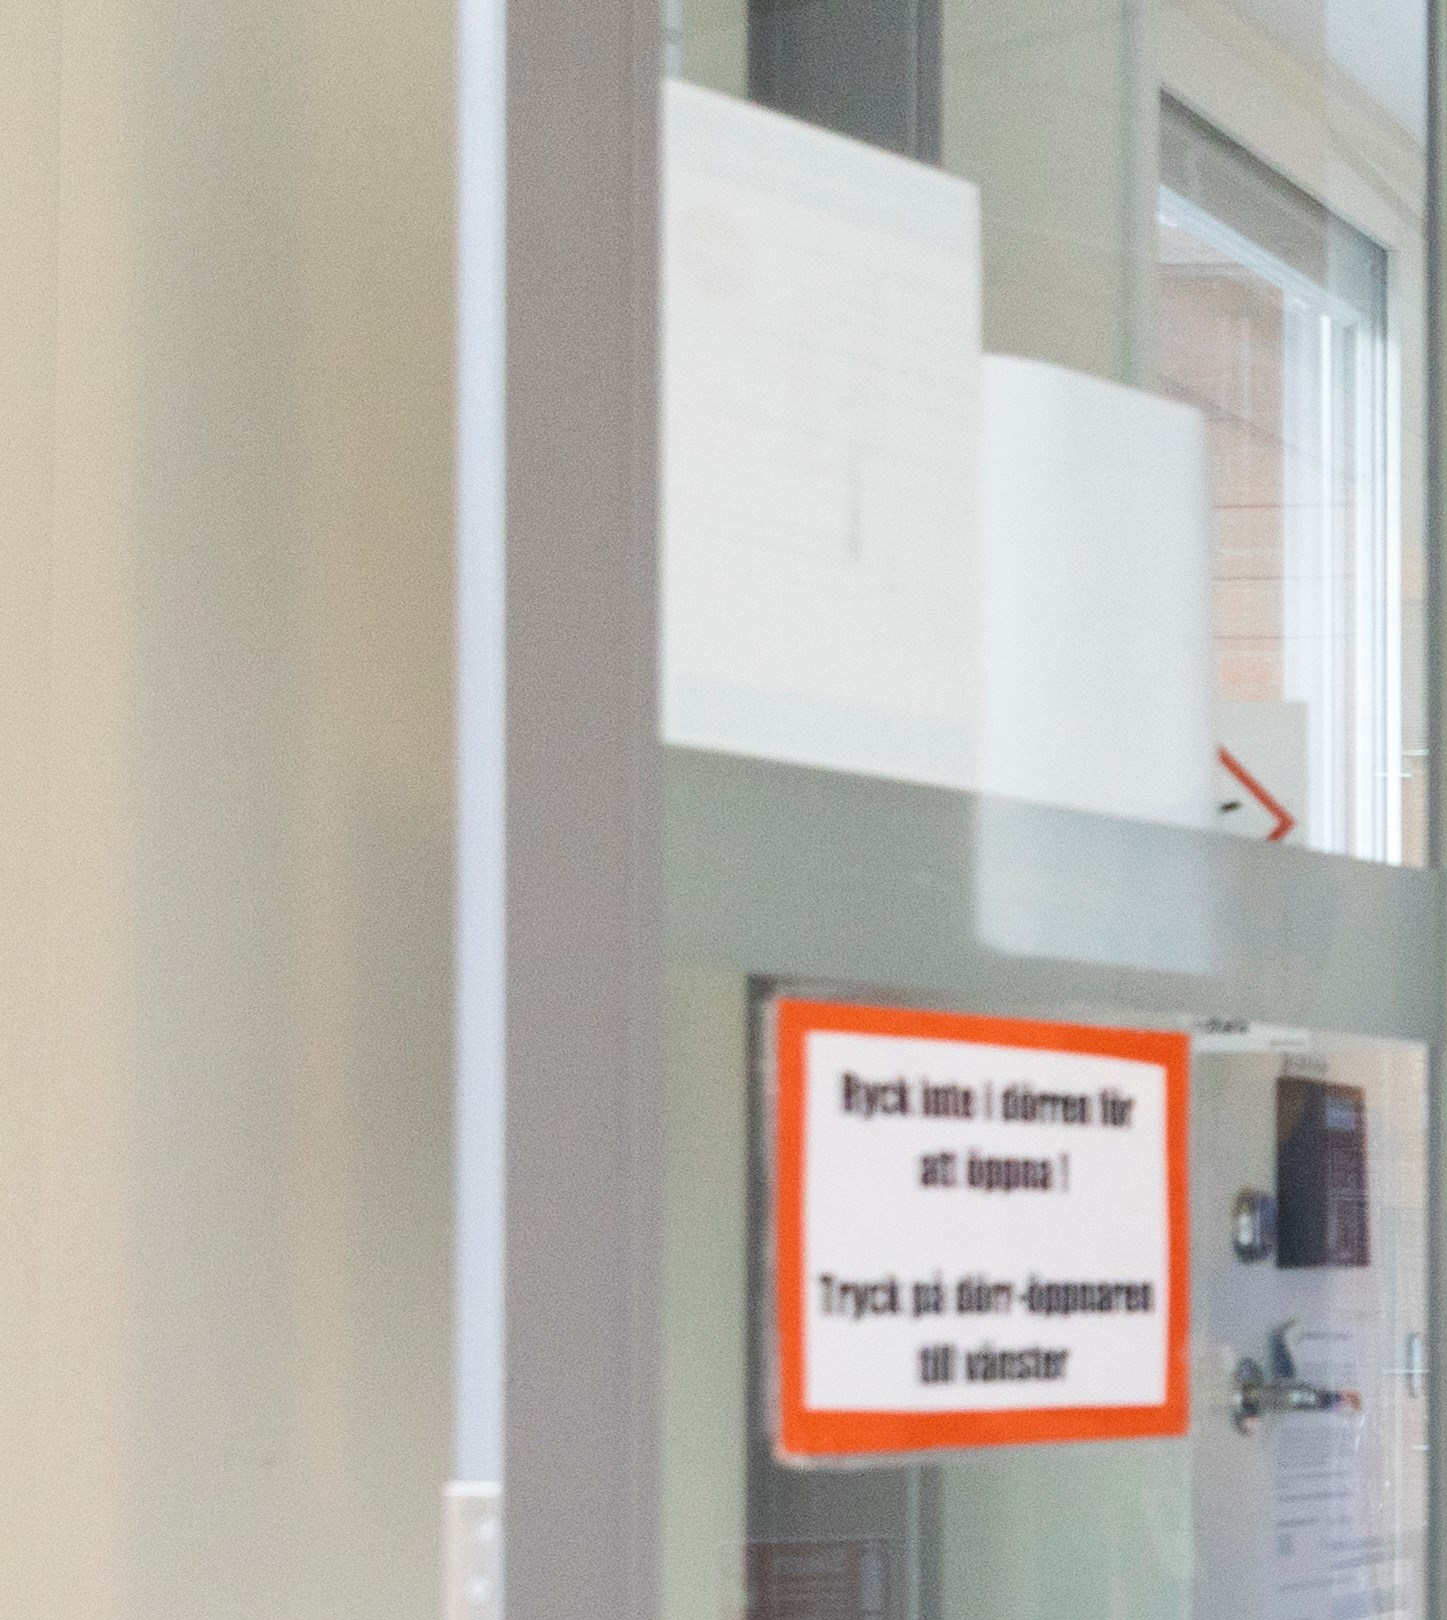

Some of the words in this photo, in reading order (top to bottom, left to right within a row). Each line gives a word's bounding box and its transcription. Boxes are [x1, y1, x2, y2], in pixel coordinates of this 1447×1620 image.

[841, 1071, 910, 1119] Ryck
[919, 1075, 973, 1119] inte
[983, 1078, 993, 1121] i
[1001, 1079, 1091, 1124] dörren
[1099, 1084, 1135, 1127] för
[920, 1149, 957, 1189] att
[966, 1146, 1052, 1193] öppna
[820, 1270, 901, 1321] Tryck
[911, 1268, 943, 1319] på
[919, 1344, 956, 1384] till
[965, 1339, 1070, 1384] vänster
